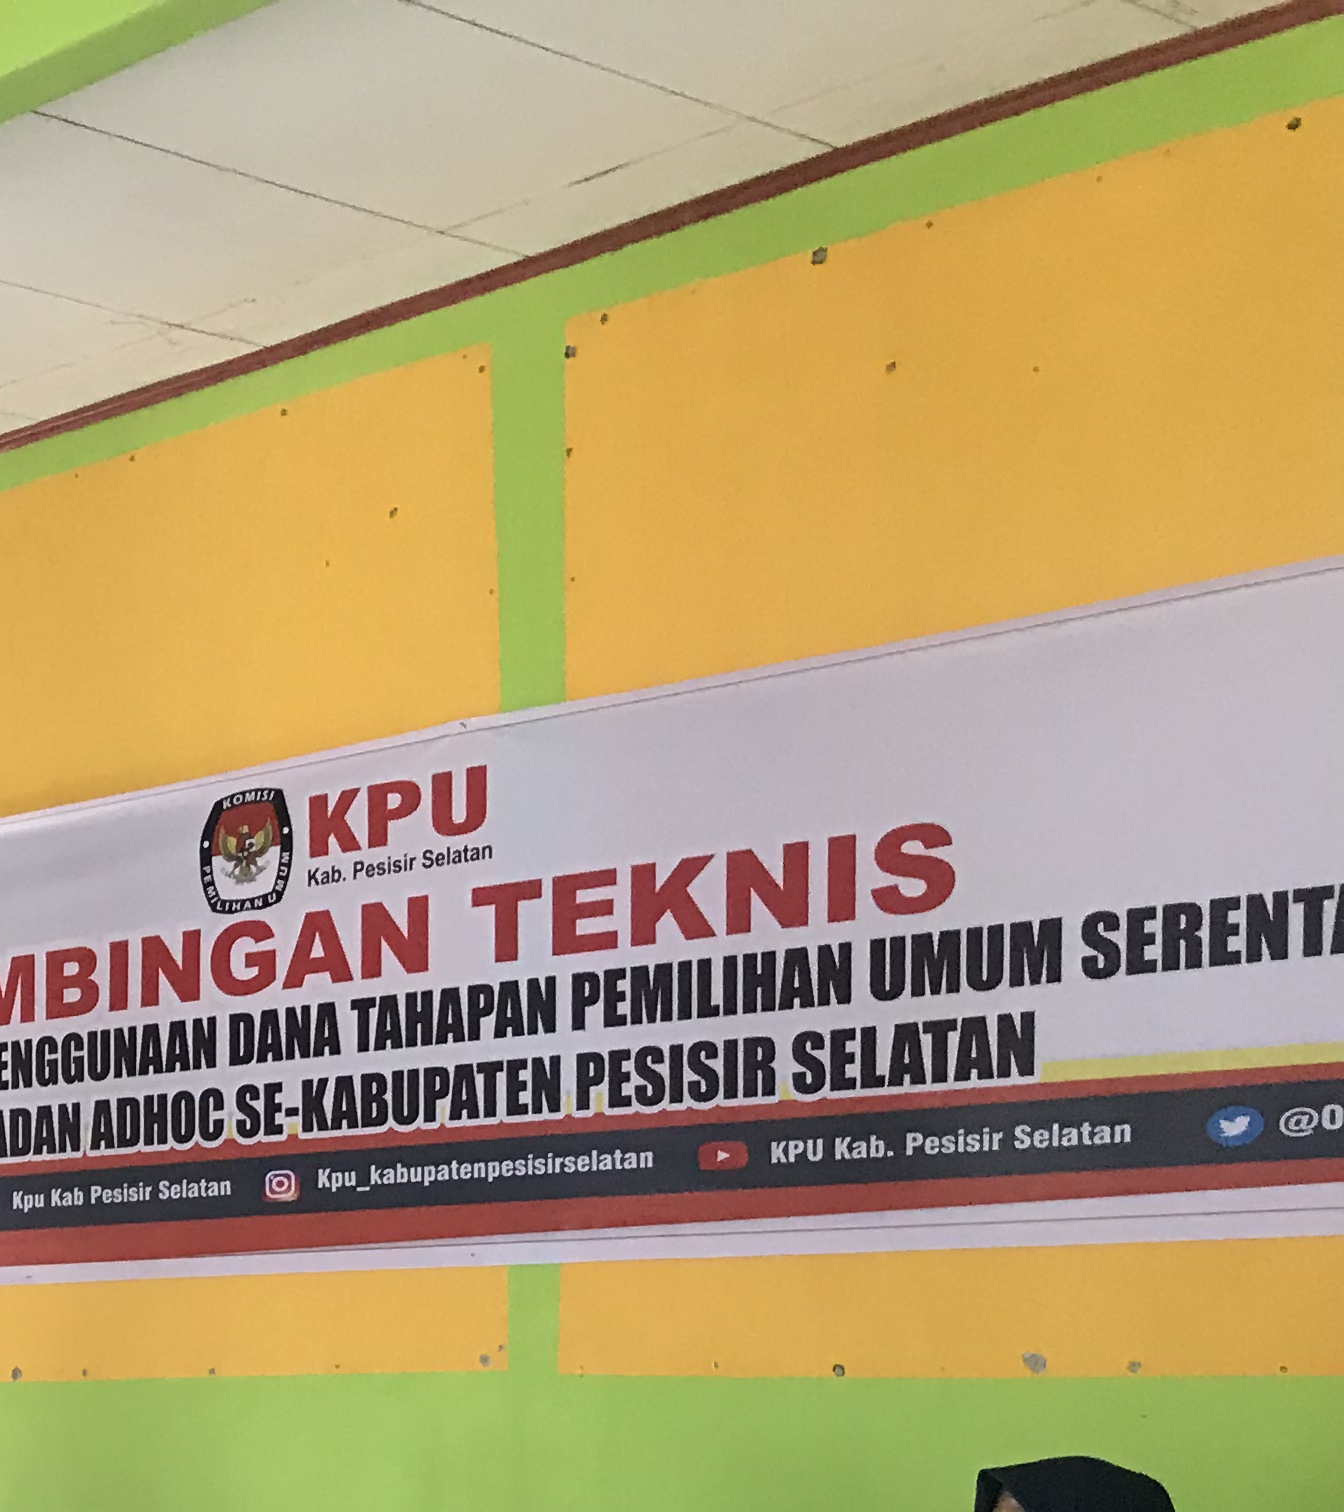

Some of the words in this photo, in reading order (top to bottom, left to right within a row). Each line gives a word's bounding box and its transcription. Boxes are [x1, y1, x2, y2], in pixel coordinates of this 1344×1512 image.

[221, 790, 275, 811] KOMISI
[308, 764, 488, 859] KPU
[202, 865, 263, 911] PEMILIHAN
[306, 867, 348, 888] Kab.
[352, 854, 415, 881] Pesisir
[421, 843, 494, 871] Selatan
[471, 821, 957, 964] TEKNIS
[228, 1001, 342, 1067] DANA
[350, 975, 557, 1053] TAHAPAN
[570, 942, 853, 1032] PEMILIHAN
[869, 916, 1063, 1002] UMUM
[91, 1084, 224, 1151] ADHOC
[235, 1054, 561, 1139] SE-KABUPATEN
[576, 1035, 777, 1113] PESISIR
[791, 1010, 1036, 1095] SELATAN
[769, 1137, 825, 1165] KPU
[834, 1133, 895, 1161] Kab.
[905, 1127, 1004, 1157] Pesisir
[1013, 1121, 1133, 1151] Selatan
[317, 1147, 654, 1193] Kpu_kabupatenpesisirselatan
[11, 1189, 45, 1211] Kpu
[50, 1186, 84, 1208] Kab
[89, 1183, 152, 1205] Pesisir
[158, 1178, 232, 1200] Selatan
